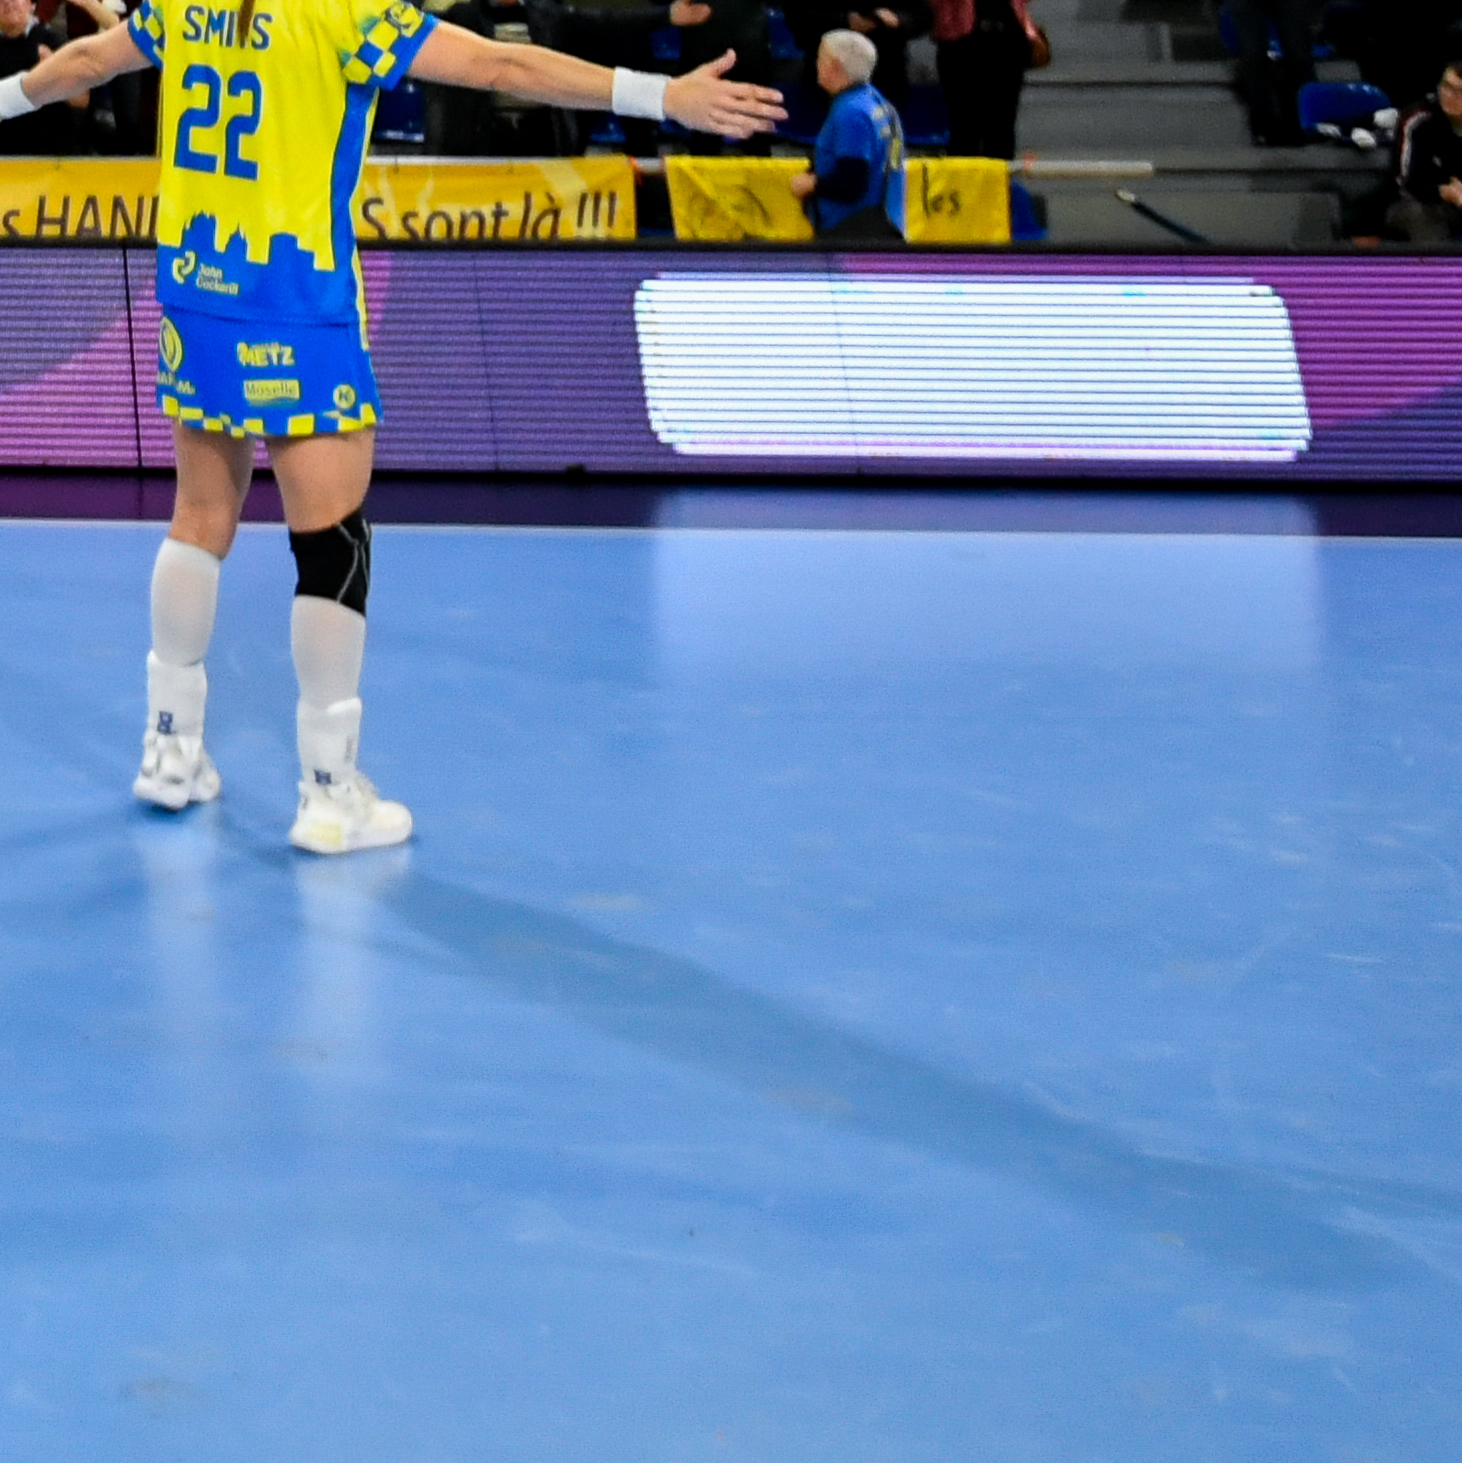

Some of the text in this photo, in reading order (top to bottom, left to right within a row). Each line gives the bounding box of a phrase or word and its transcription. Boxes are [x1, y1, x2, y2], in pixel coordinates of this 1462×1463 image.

[182, 4, 274, 51] SMIS
[173, 63, 263, 181] 22
[35, 194, 160, 238] HAN
